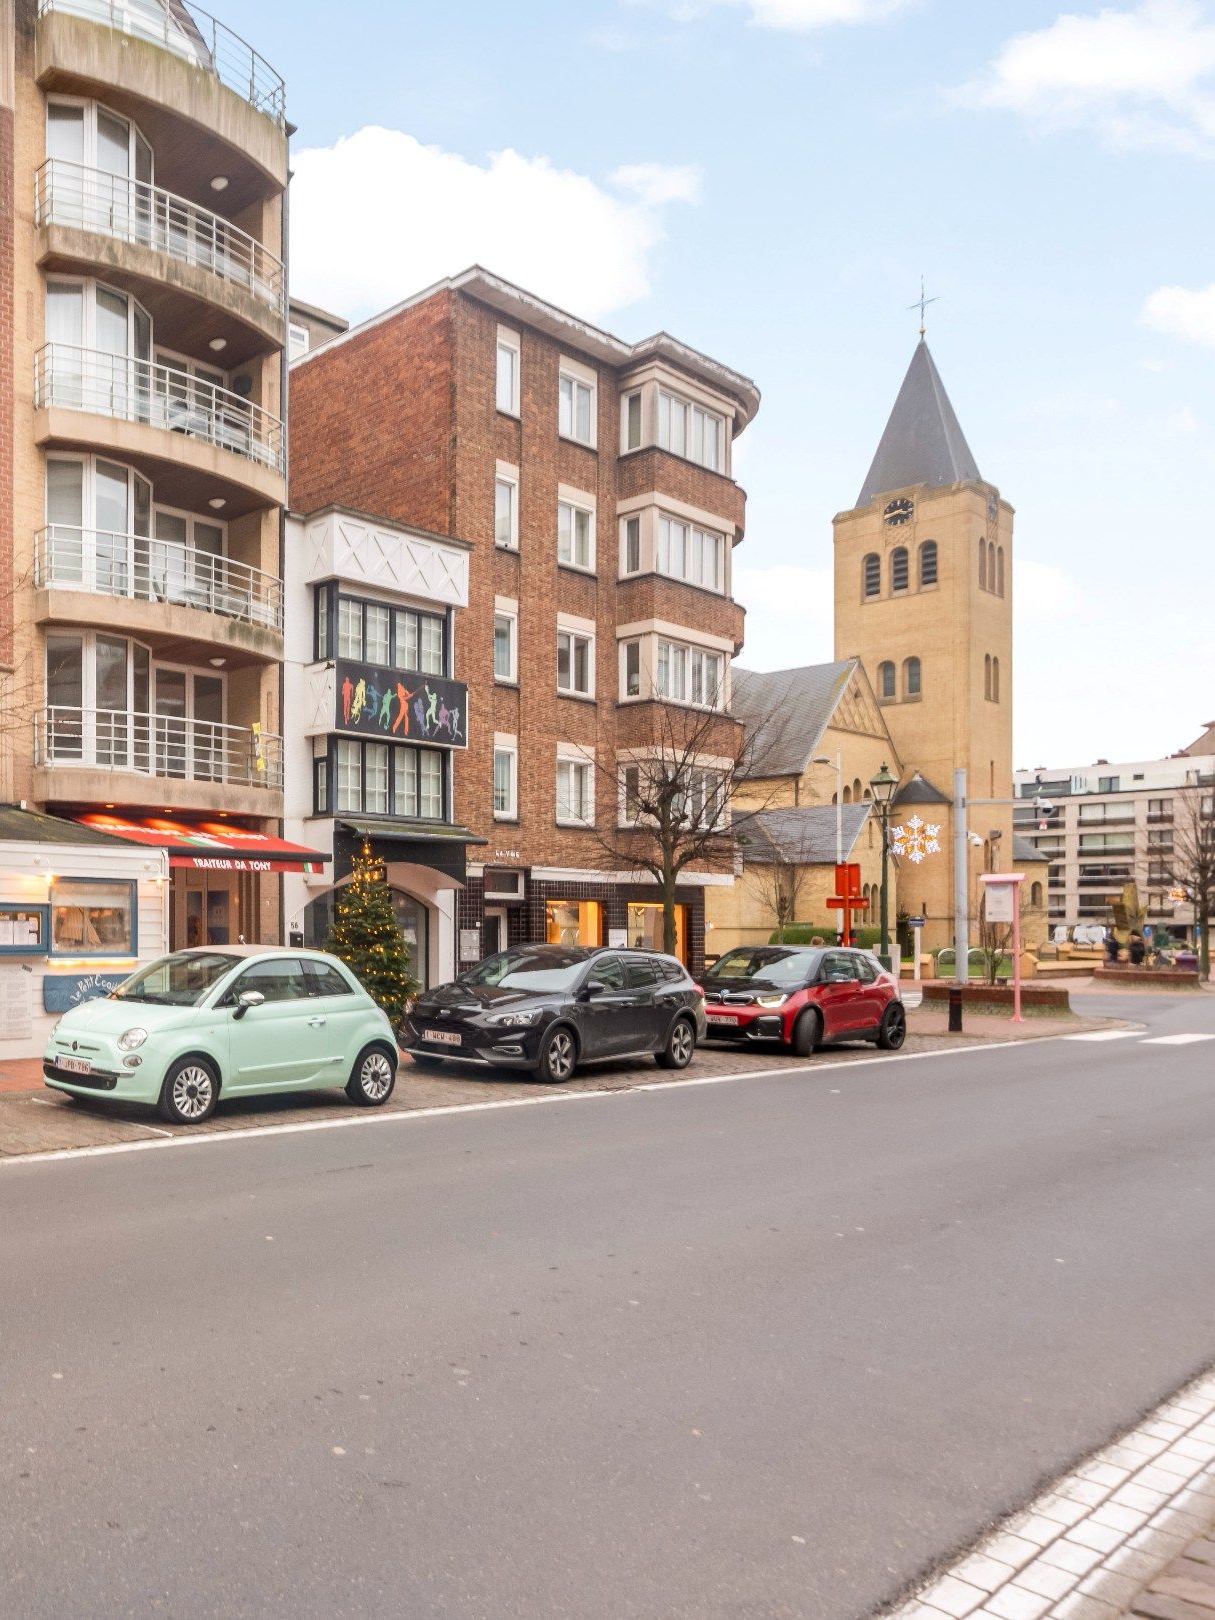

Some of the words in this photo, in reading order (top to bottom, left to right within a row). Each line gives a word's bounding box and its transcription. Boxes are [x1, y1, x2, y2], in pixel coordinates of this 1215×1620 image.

[193, 857, 233, 869] TRAITEUR
[234, 860, 247, 871] DA
[249, 861, 271, 871] TONY
